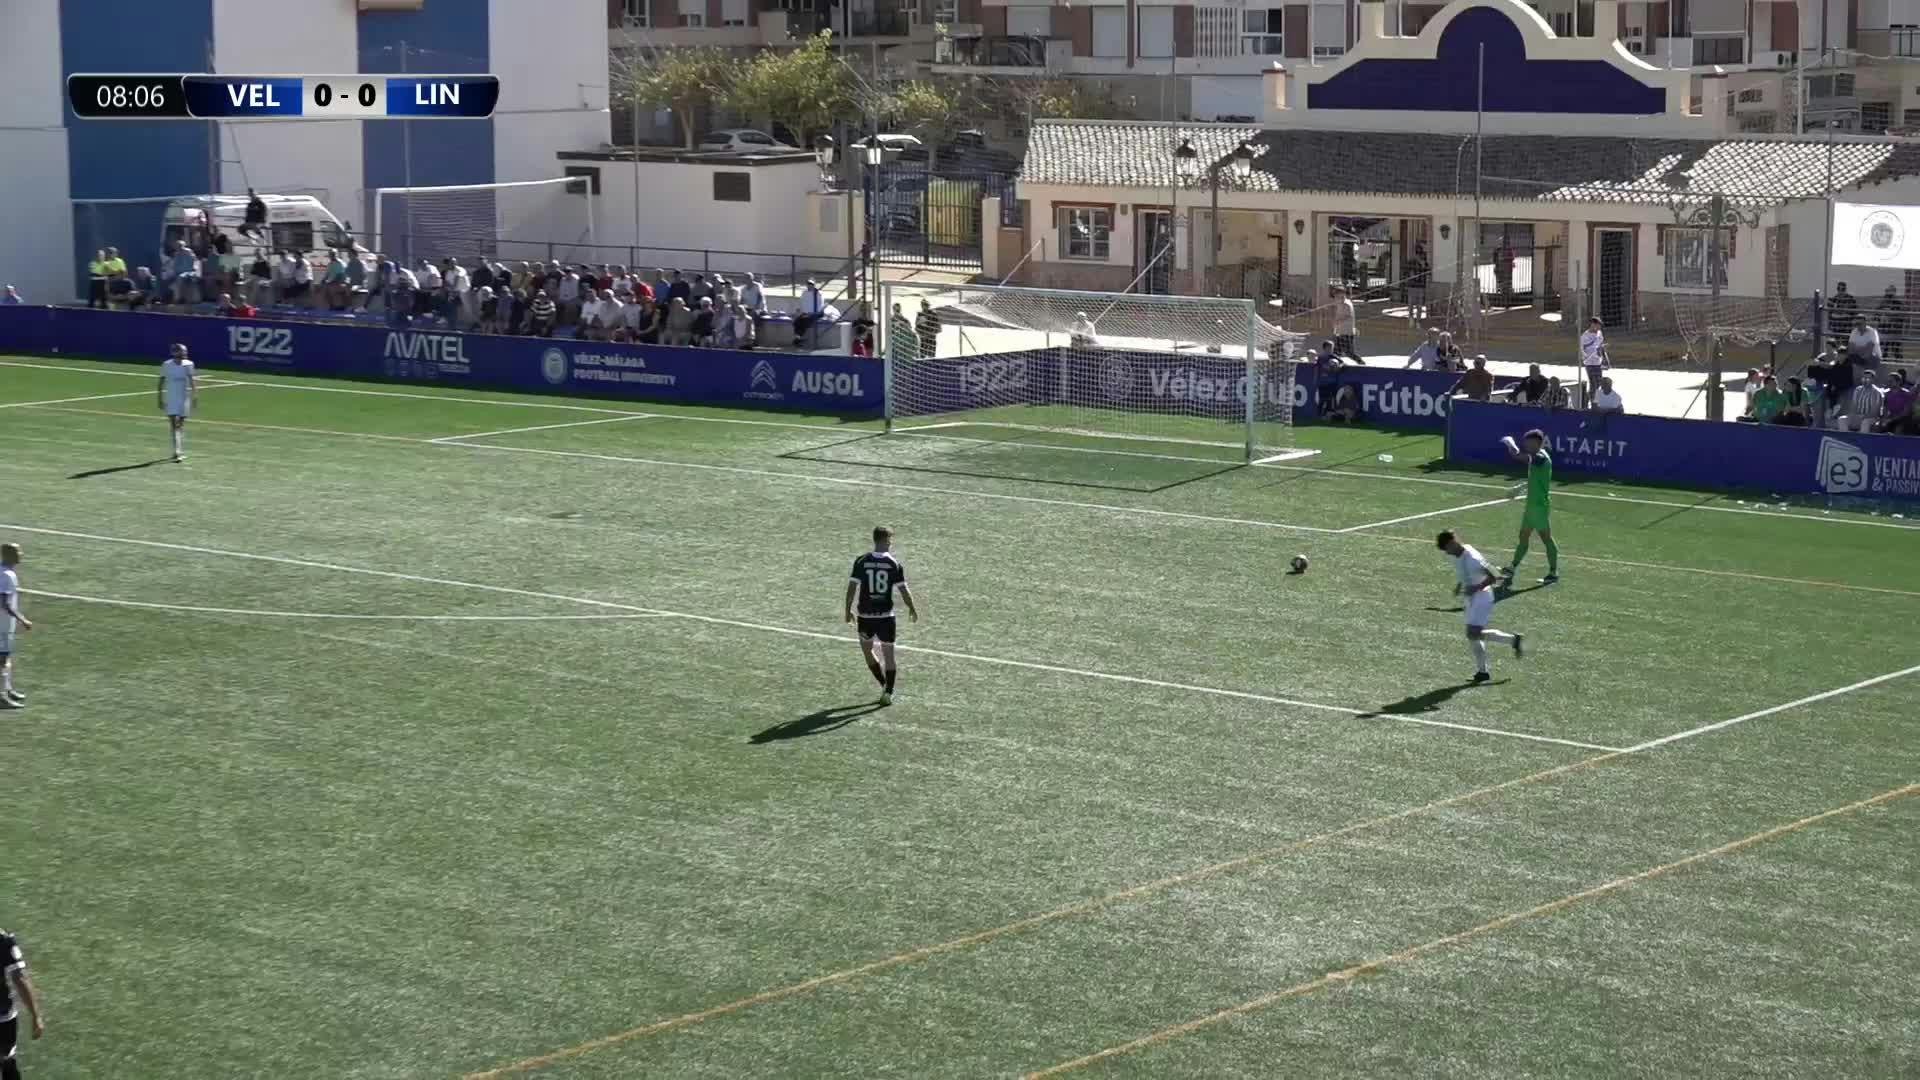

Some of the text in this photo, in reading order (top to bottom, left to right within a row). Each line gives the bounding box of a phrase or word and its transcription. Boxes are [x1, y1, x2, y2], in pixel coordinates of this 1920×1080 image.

[227, 326, 293, 356] 1922
[384, 332, 470, 363] AVATEL
[792, 369, 865, 397] AUSOL
[1150, 366, 1229, 401] Vélez
[1541, 435, 1628, 457] ALTAFIT
[1830, 455, 1864, 488] e3
[865, 569, 888, 593] 18
